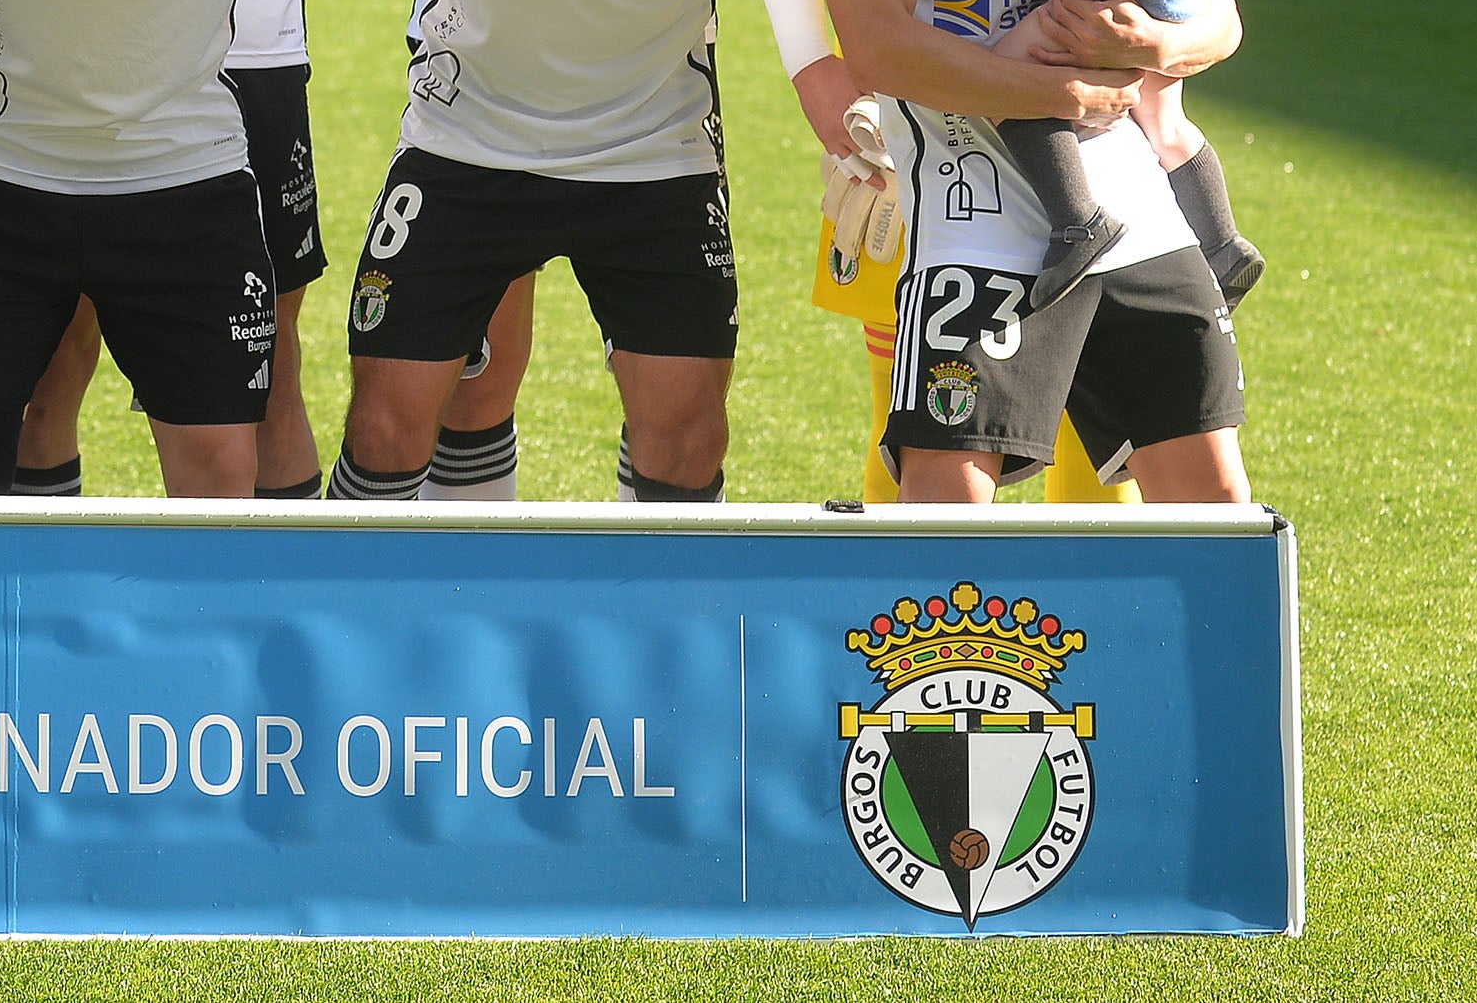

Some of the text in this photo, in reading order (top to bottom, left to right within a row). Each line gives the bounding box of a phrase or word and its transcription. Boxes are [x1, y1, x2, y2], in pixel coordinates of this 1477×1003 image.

[370, 183, 423, 259] 8
[871, 200, 896, 254] TWOFIVE
[925, 267, 1025, 360] 23
[919, 679, 1013, 710] CLUB
[337, 715, 676, 800] OFICIAL
[850, 745, 925, 890] BURGOS
[1014, 748, 1086, 885] FUTBOL
